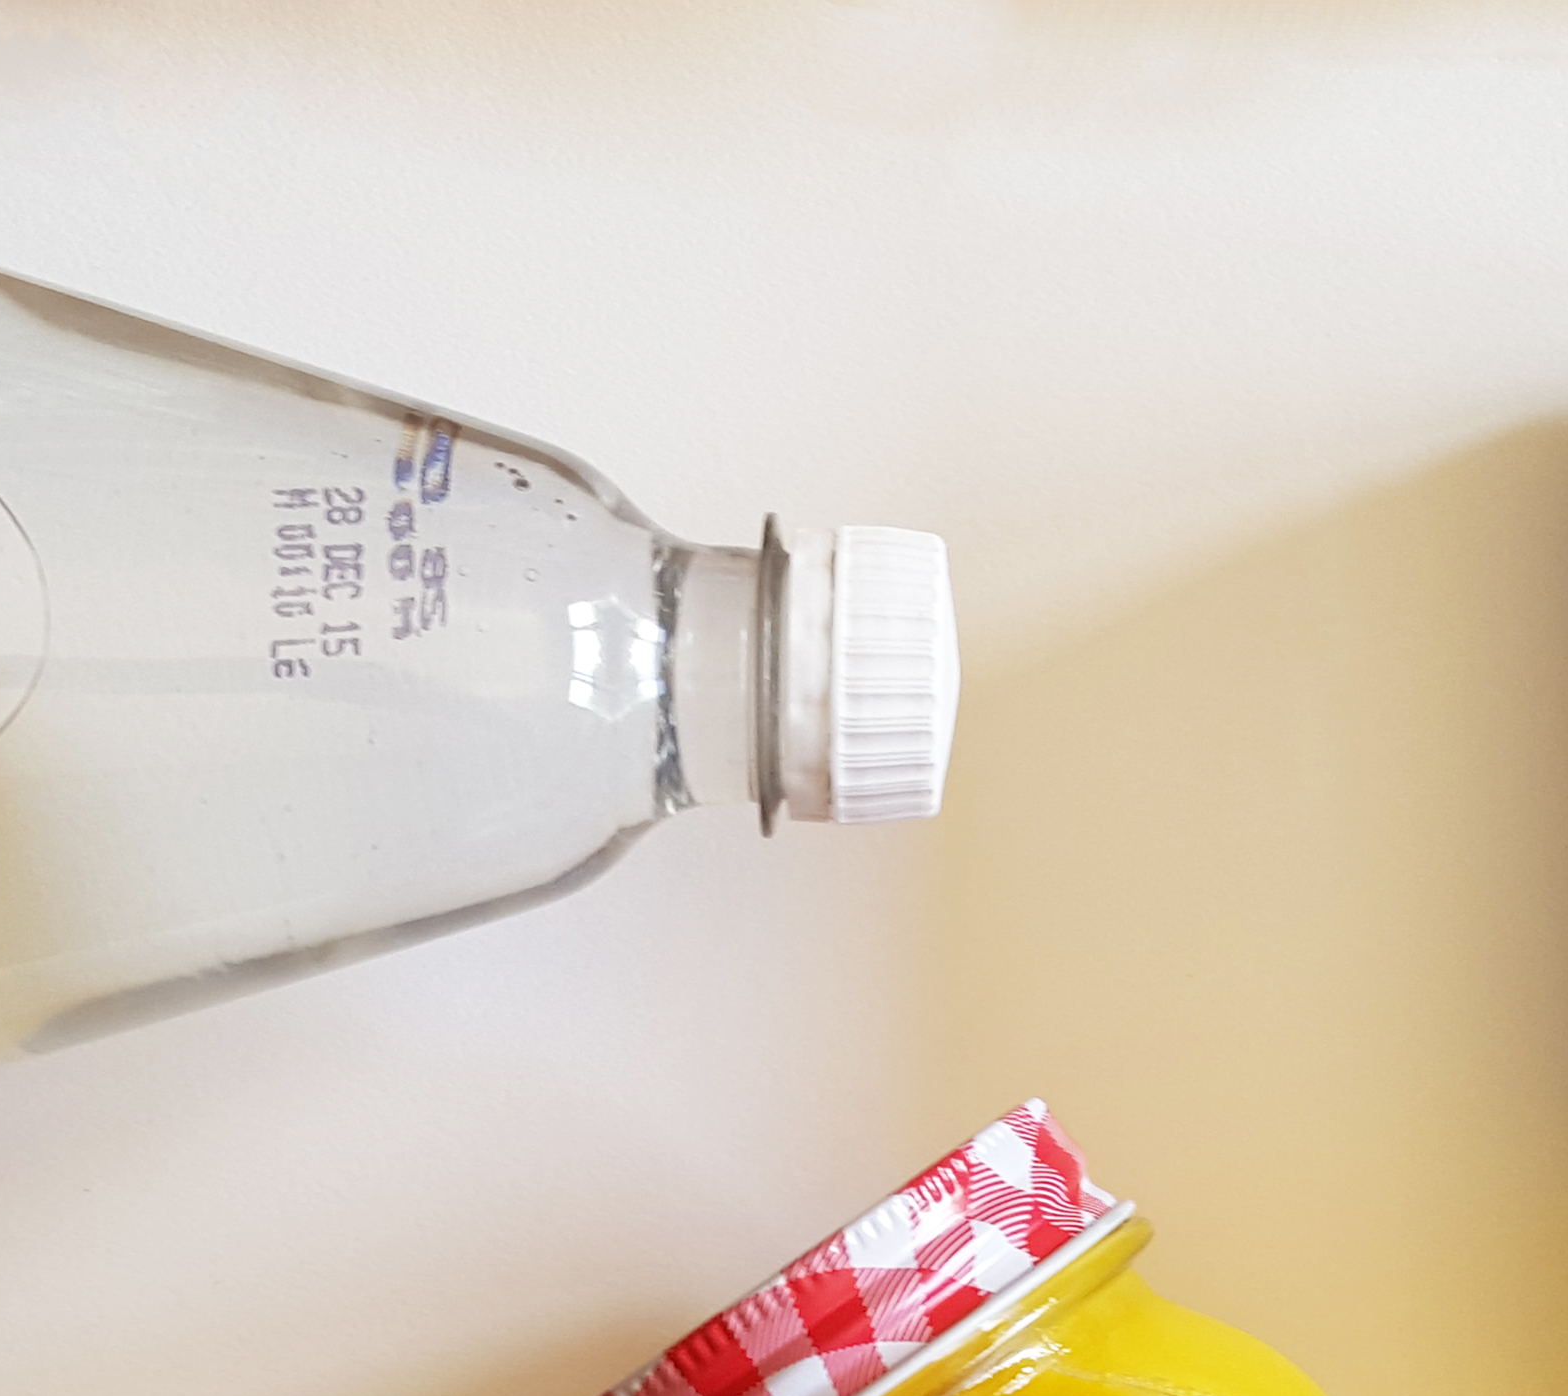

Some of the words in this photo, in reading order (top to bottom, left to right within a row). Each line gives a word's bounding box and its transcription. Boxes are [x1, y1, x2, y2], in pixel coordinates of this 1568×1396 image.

[322, 486, 365, 527] 28
[320, 541, 364, 601] DEC
[321, 619, 363, 658] 15
